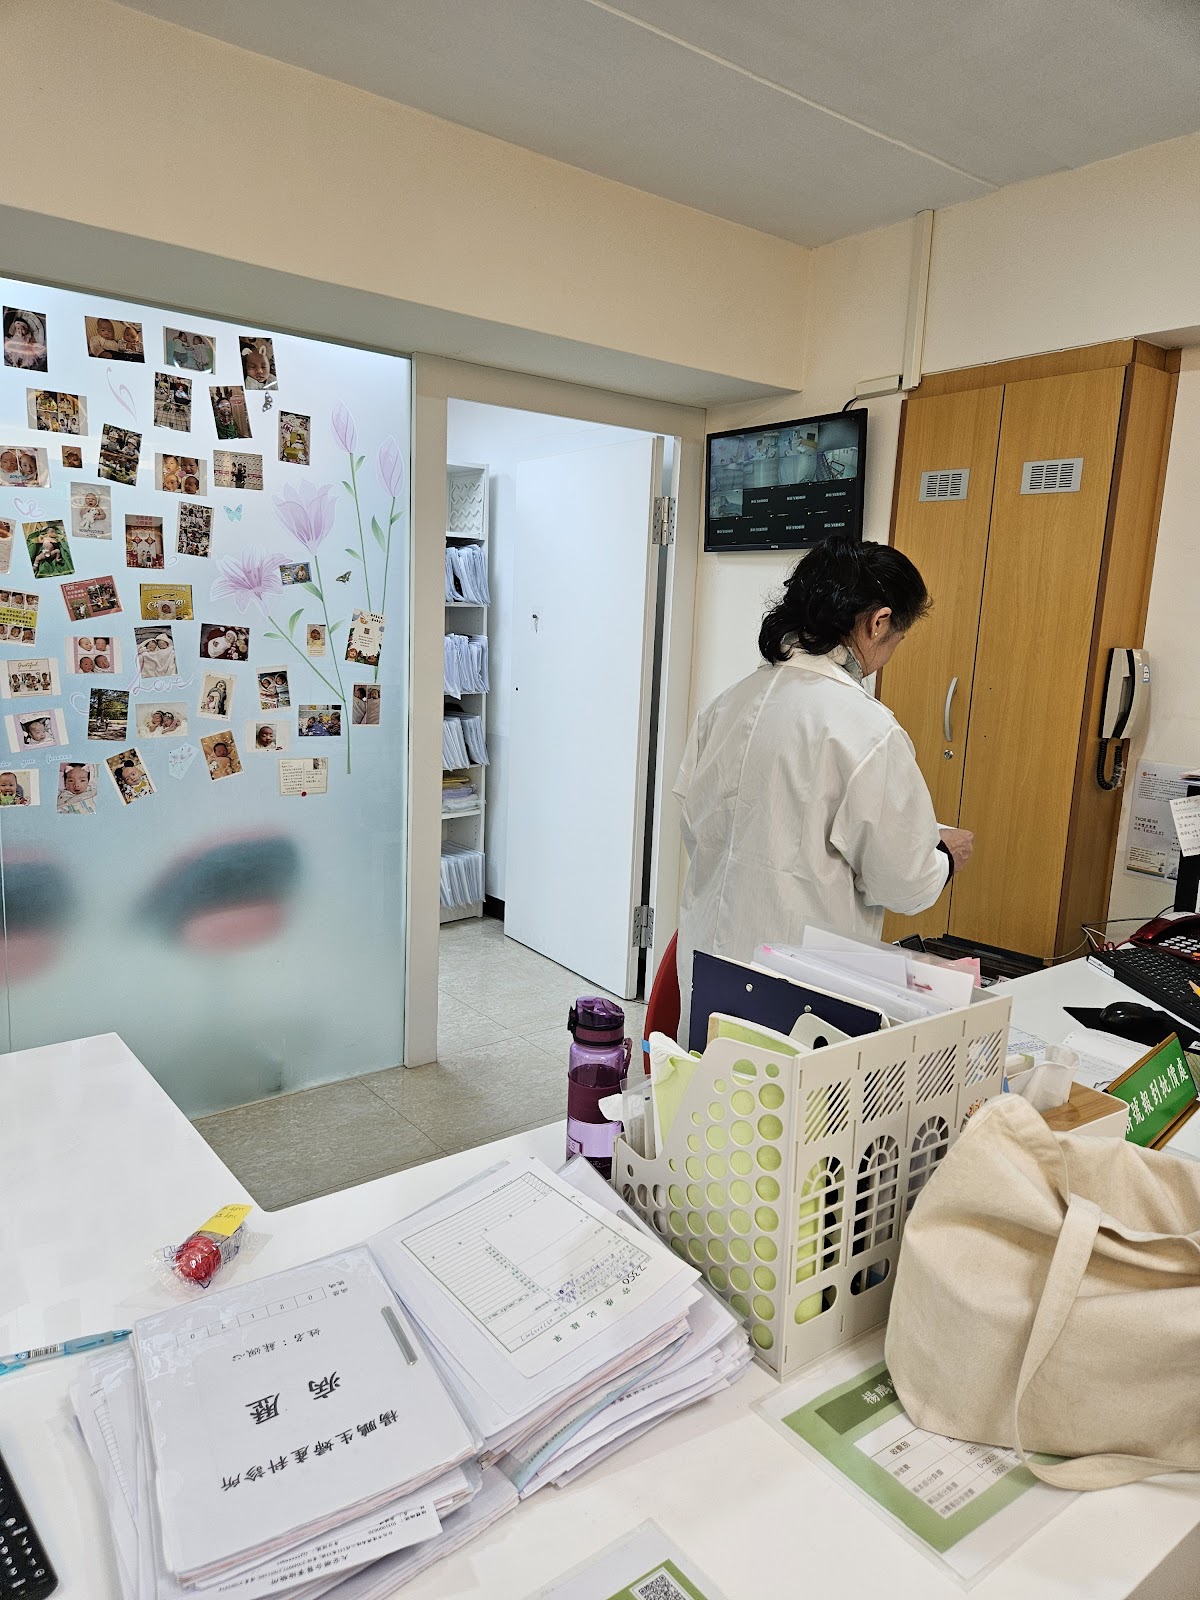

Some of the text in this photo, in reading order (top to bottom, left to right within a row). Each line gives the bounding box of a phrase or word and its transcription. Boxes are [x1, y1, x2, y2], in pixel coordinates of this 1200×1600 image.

[218, 1408, 400, 1492] 楊鵬生婦產科診所
